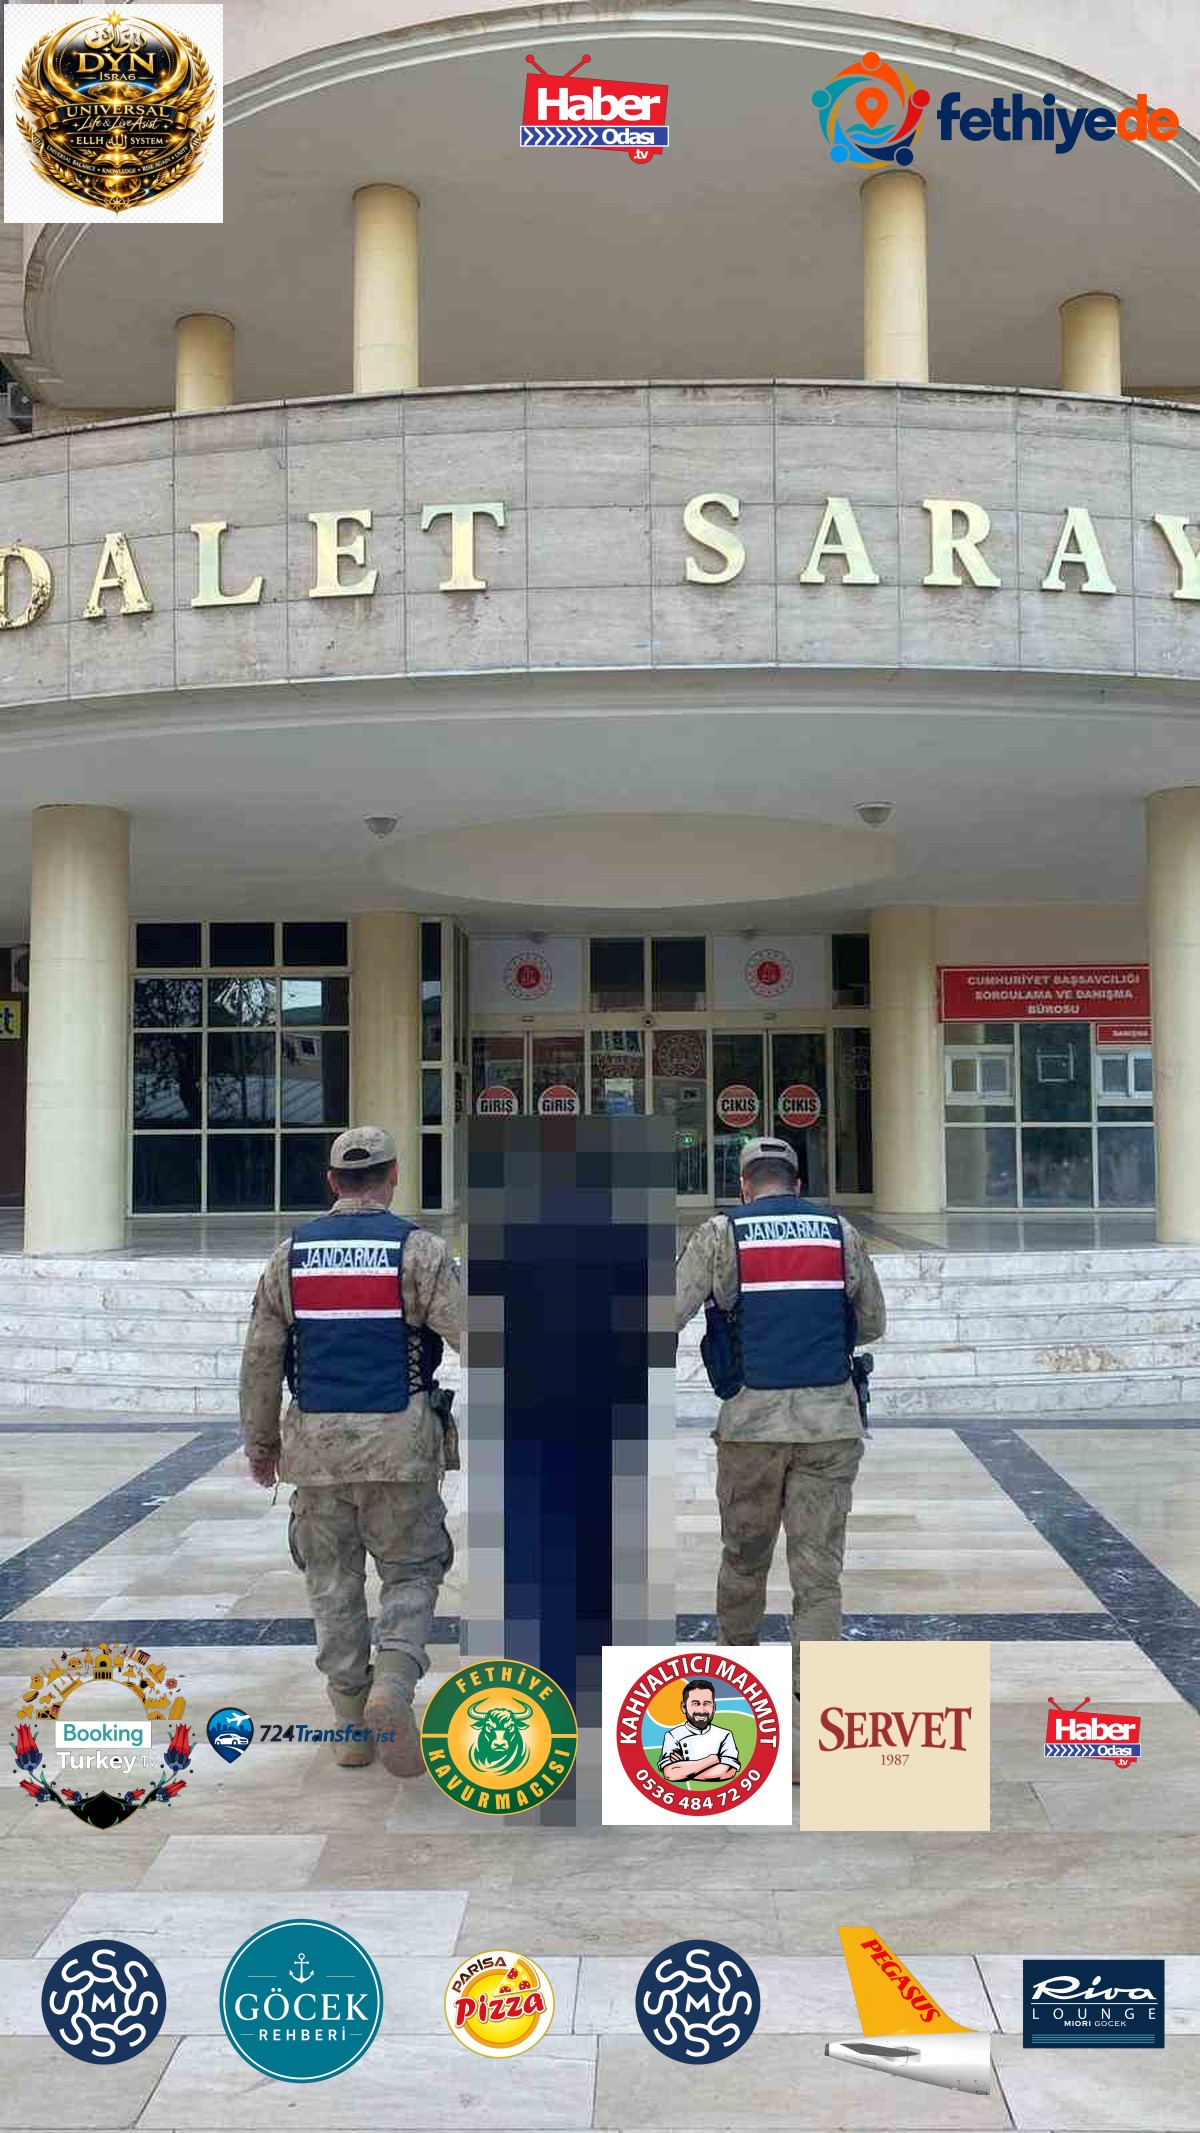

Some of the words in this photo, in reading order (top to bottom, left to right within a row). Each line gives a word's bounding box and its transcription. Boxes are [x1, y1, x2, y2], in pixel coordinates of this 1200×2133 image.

[975, 990, 1053, 1000] SORGULAMA
[1056, 989, 1074, 999] VE
[1028, 1002, 1080, 1014] BÜROSU
[745, 1221, 832, 1240] JANDARMA
[301, 1248, 389, 1268] JANDARMA
